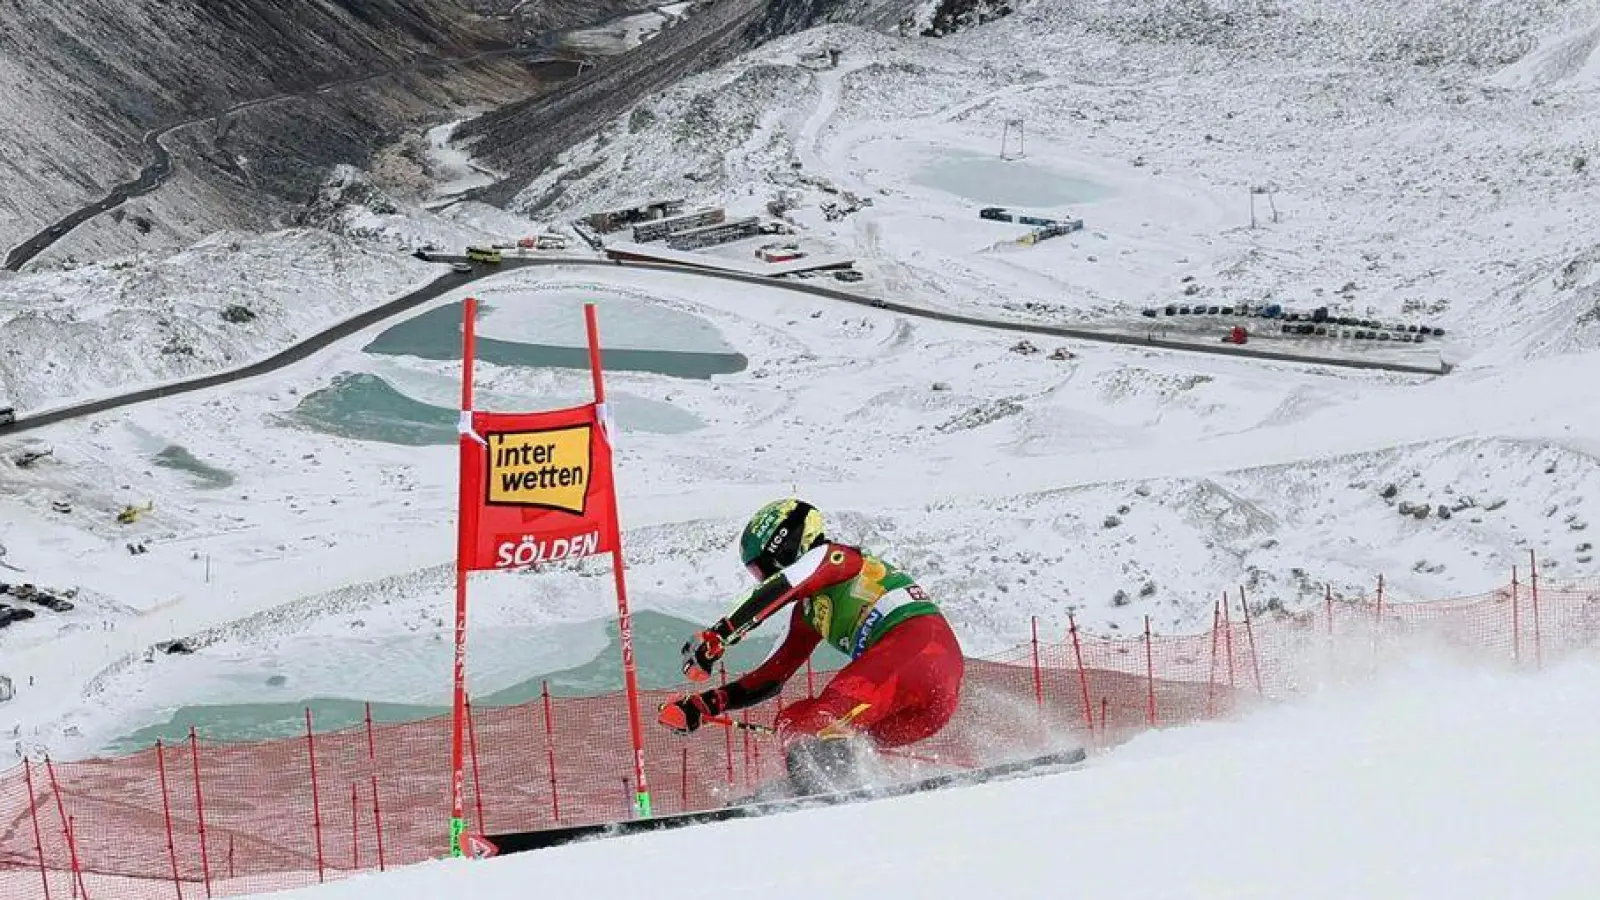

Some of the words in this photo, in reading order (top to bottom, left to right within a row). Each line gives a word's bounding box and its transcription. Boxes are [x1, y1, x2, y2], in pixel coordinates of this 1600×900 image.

[496, 433, 555, 468] inter
[502, 465, 583, 492] wetten
[496, 531, 599, 566] SÖLDEN
